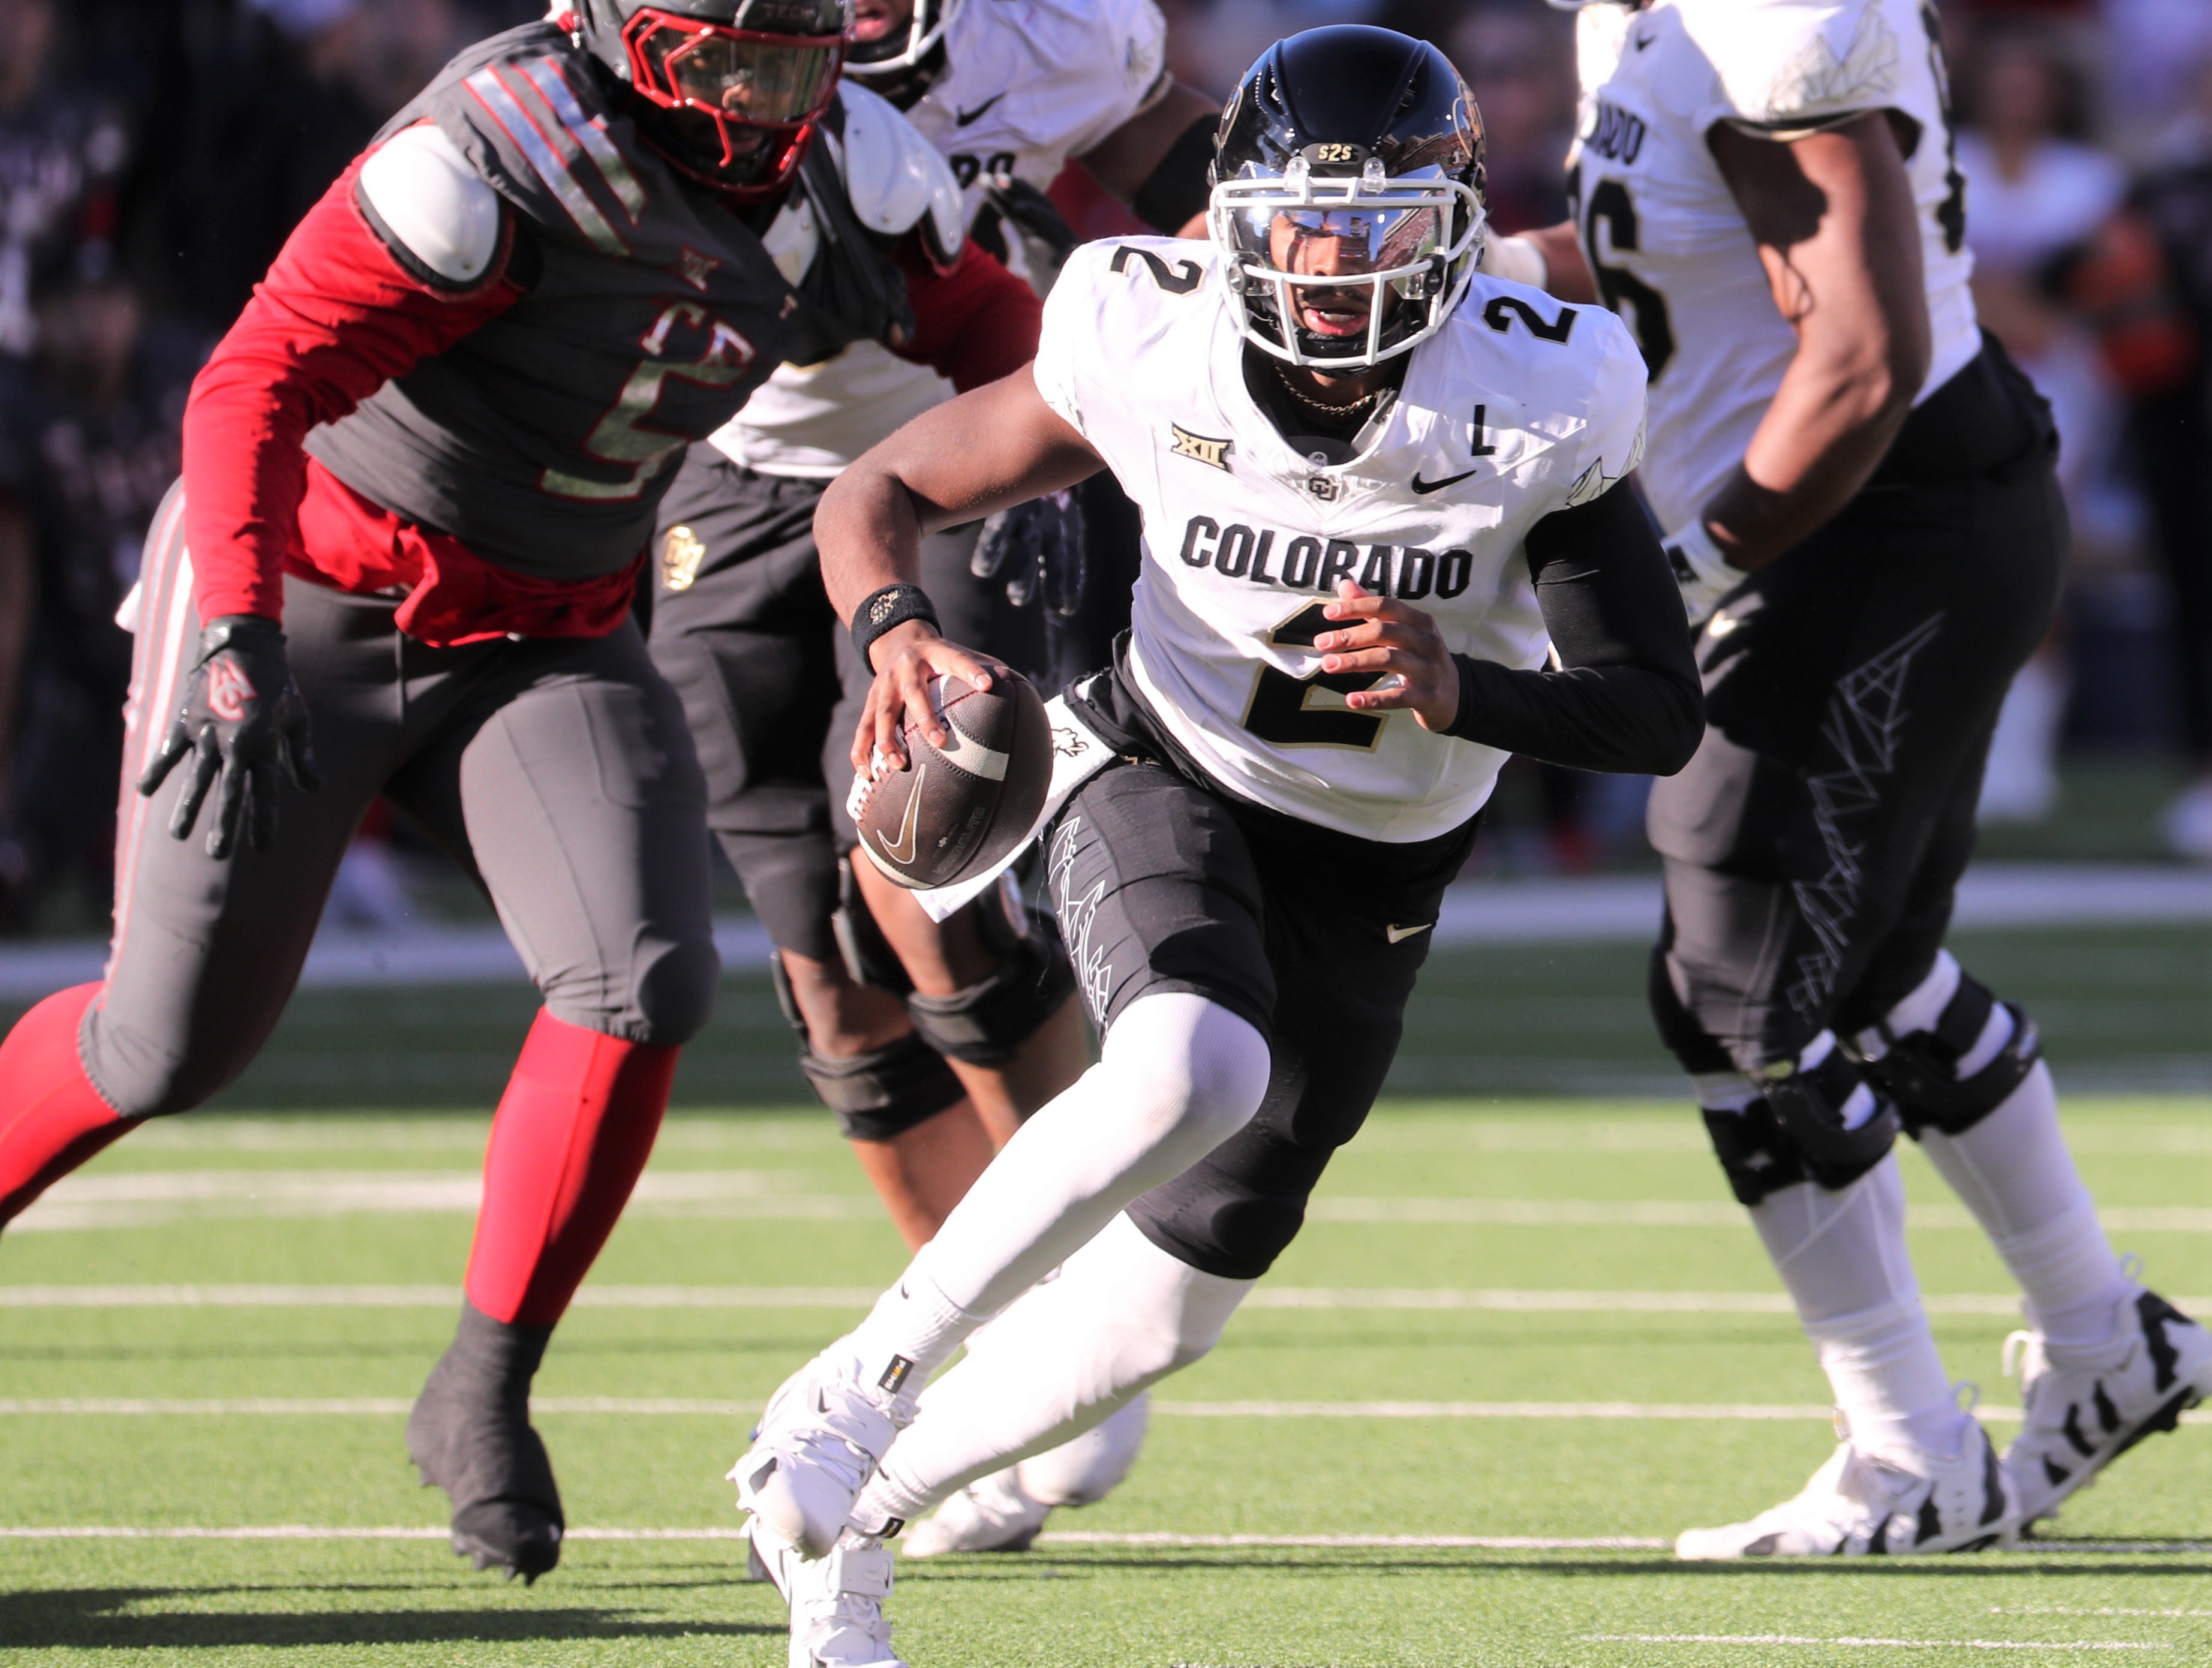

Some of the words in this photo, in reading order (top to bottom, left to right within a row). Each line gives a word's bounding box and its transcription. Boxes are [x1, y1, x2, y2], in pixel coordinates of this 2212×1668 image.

[1110, 245, 1208, 297] 2
[1567, 165, 1678, 385] 6
[1481, 296, 1579, 345] 2
[1471, 404, 1496, 456] L
[1180, 515, 1474, 599] COLORADO
[1242, 598, 1390, 753] 2
